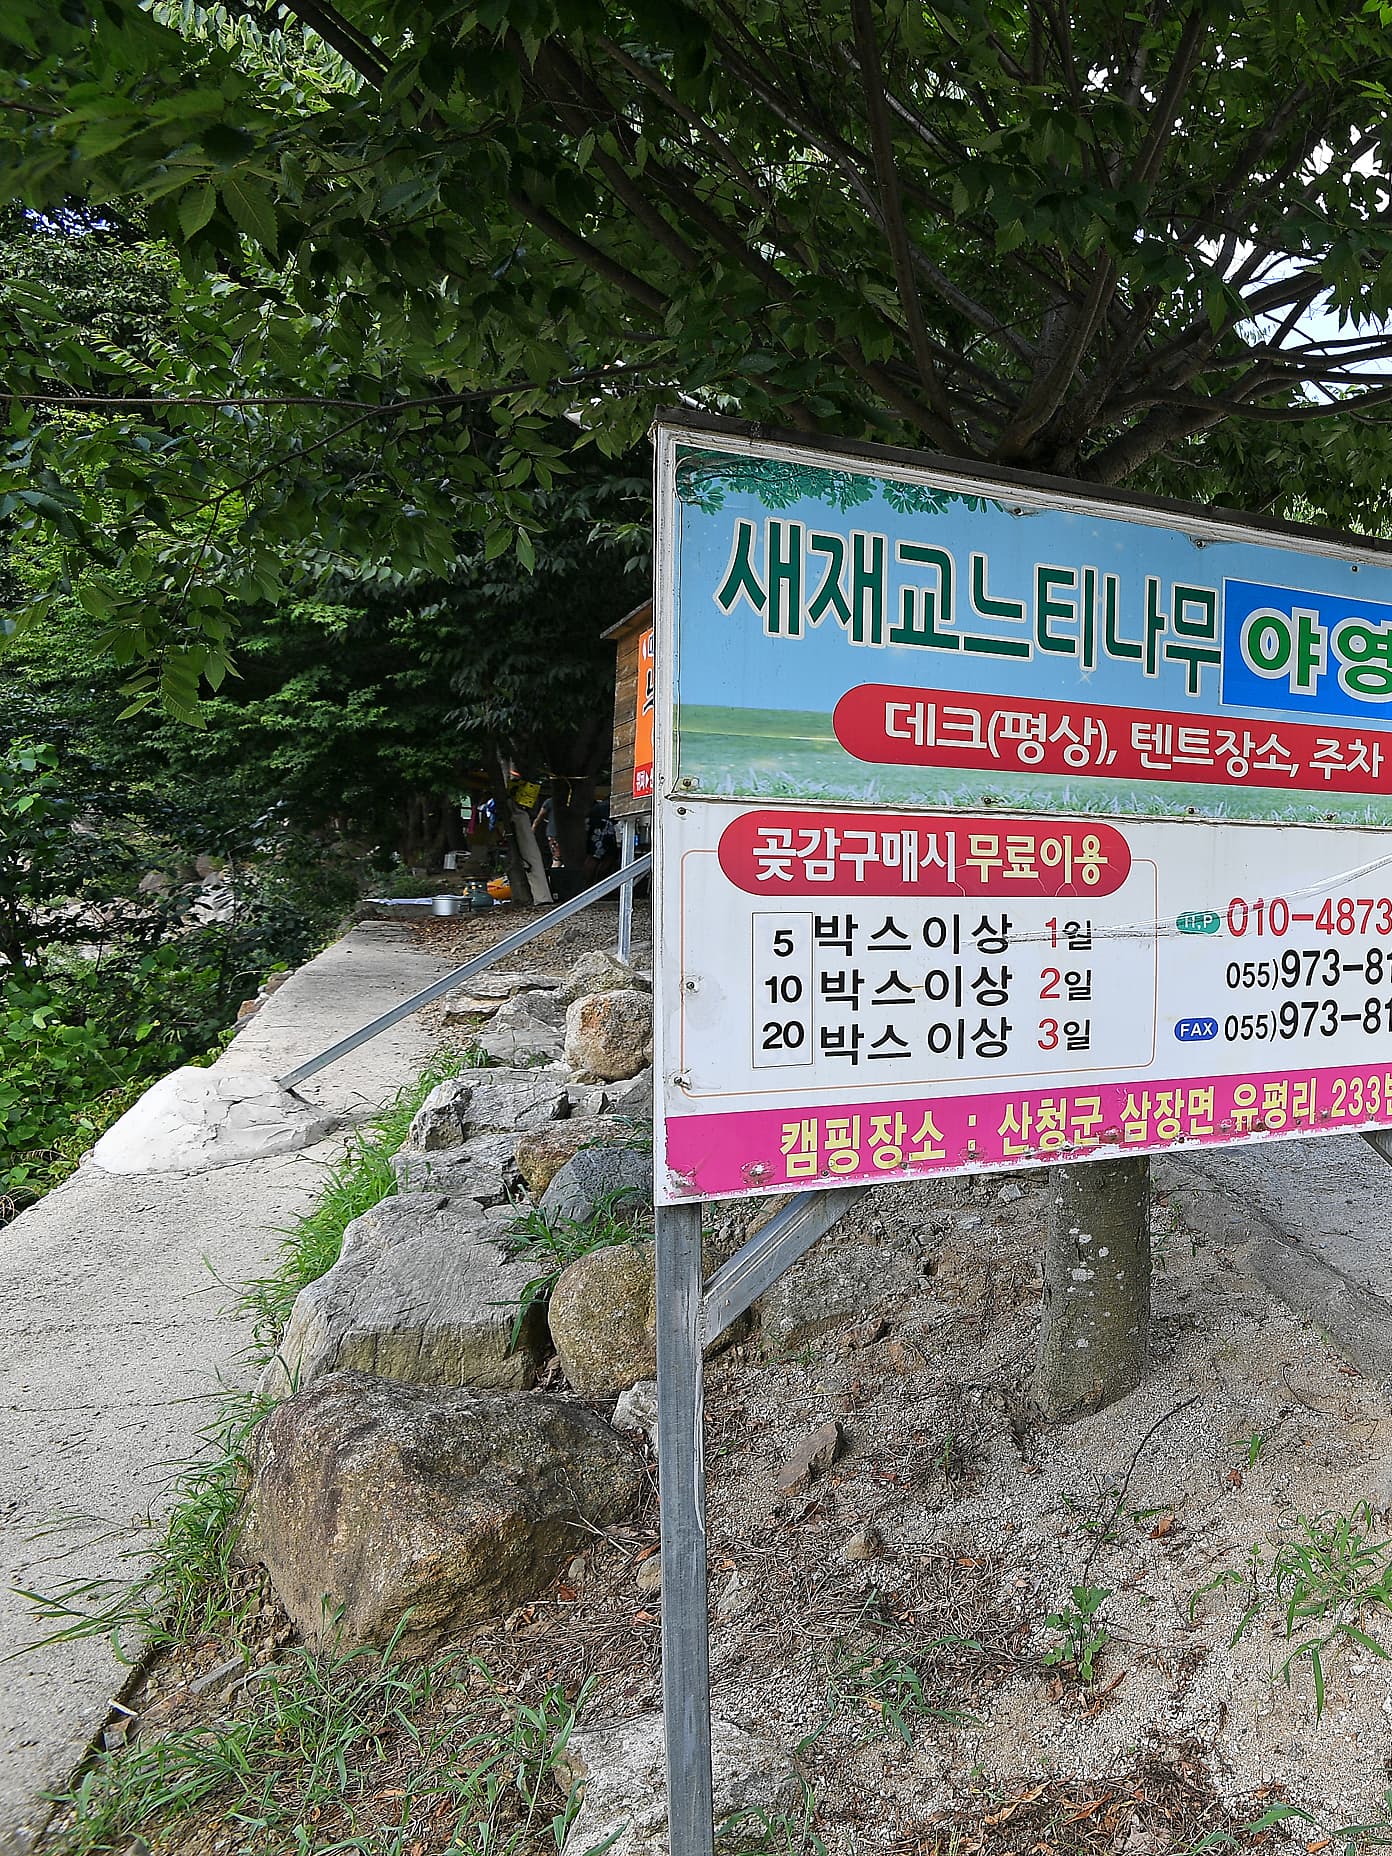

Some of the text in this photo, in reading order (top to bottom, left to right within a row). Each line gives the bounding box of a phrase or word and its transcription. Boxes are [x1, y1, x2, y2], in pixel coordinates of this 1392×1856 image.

[1131, 723, 1298, 778] 텐트장소,
[1309, 737, 1385, 780] 주차
[966, 834, 1109, 886] 무료이용
[773, 930, 794, 957] 5
[765, 975, 804, 1004] 10
[762, 1021, 805, 1050] 20
[1180, 1022, 1214, 1037] FAX
[780, 1110, 946, 1177] 캠핑장소
[997, 1096, 1104, 1156] 산청군
[1119, 1086, 1215, 1143] 삼장면
[1230, 1077, 1317, 1133] 유평리
